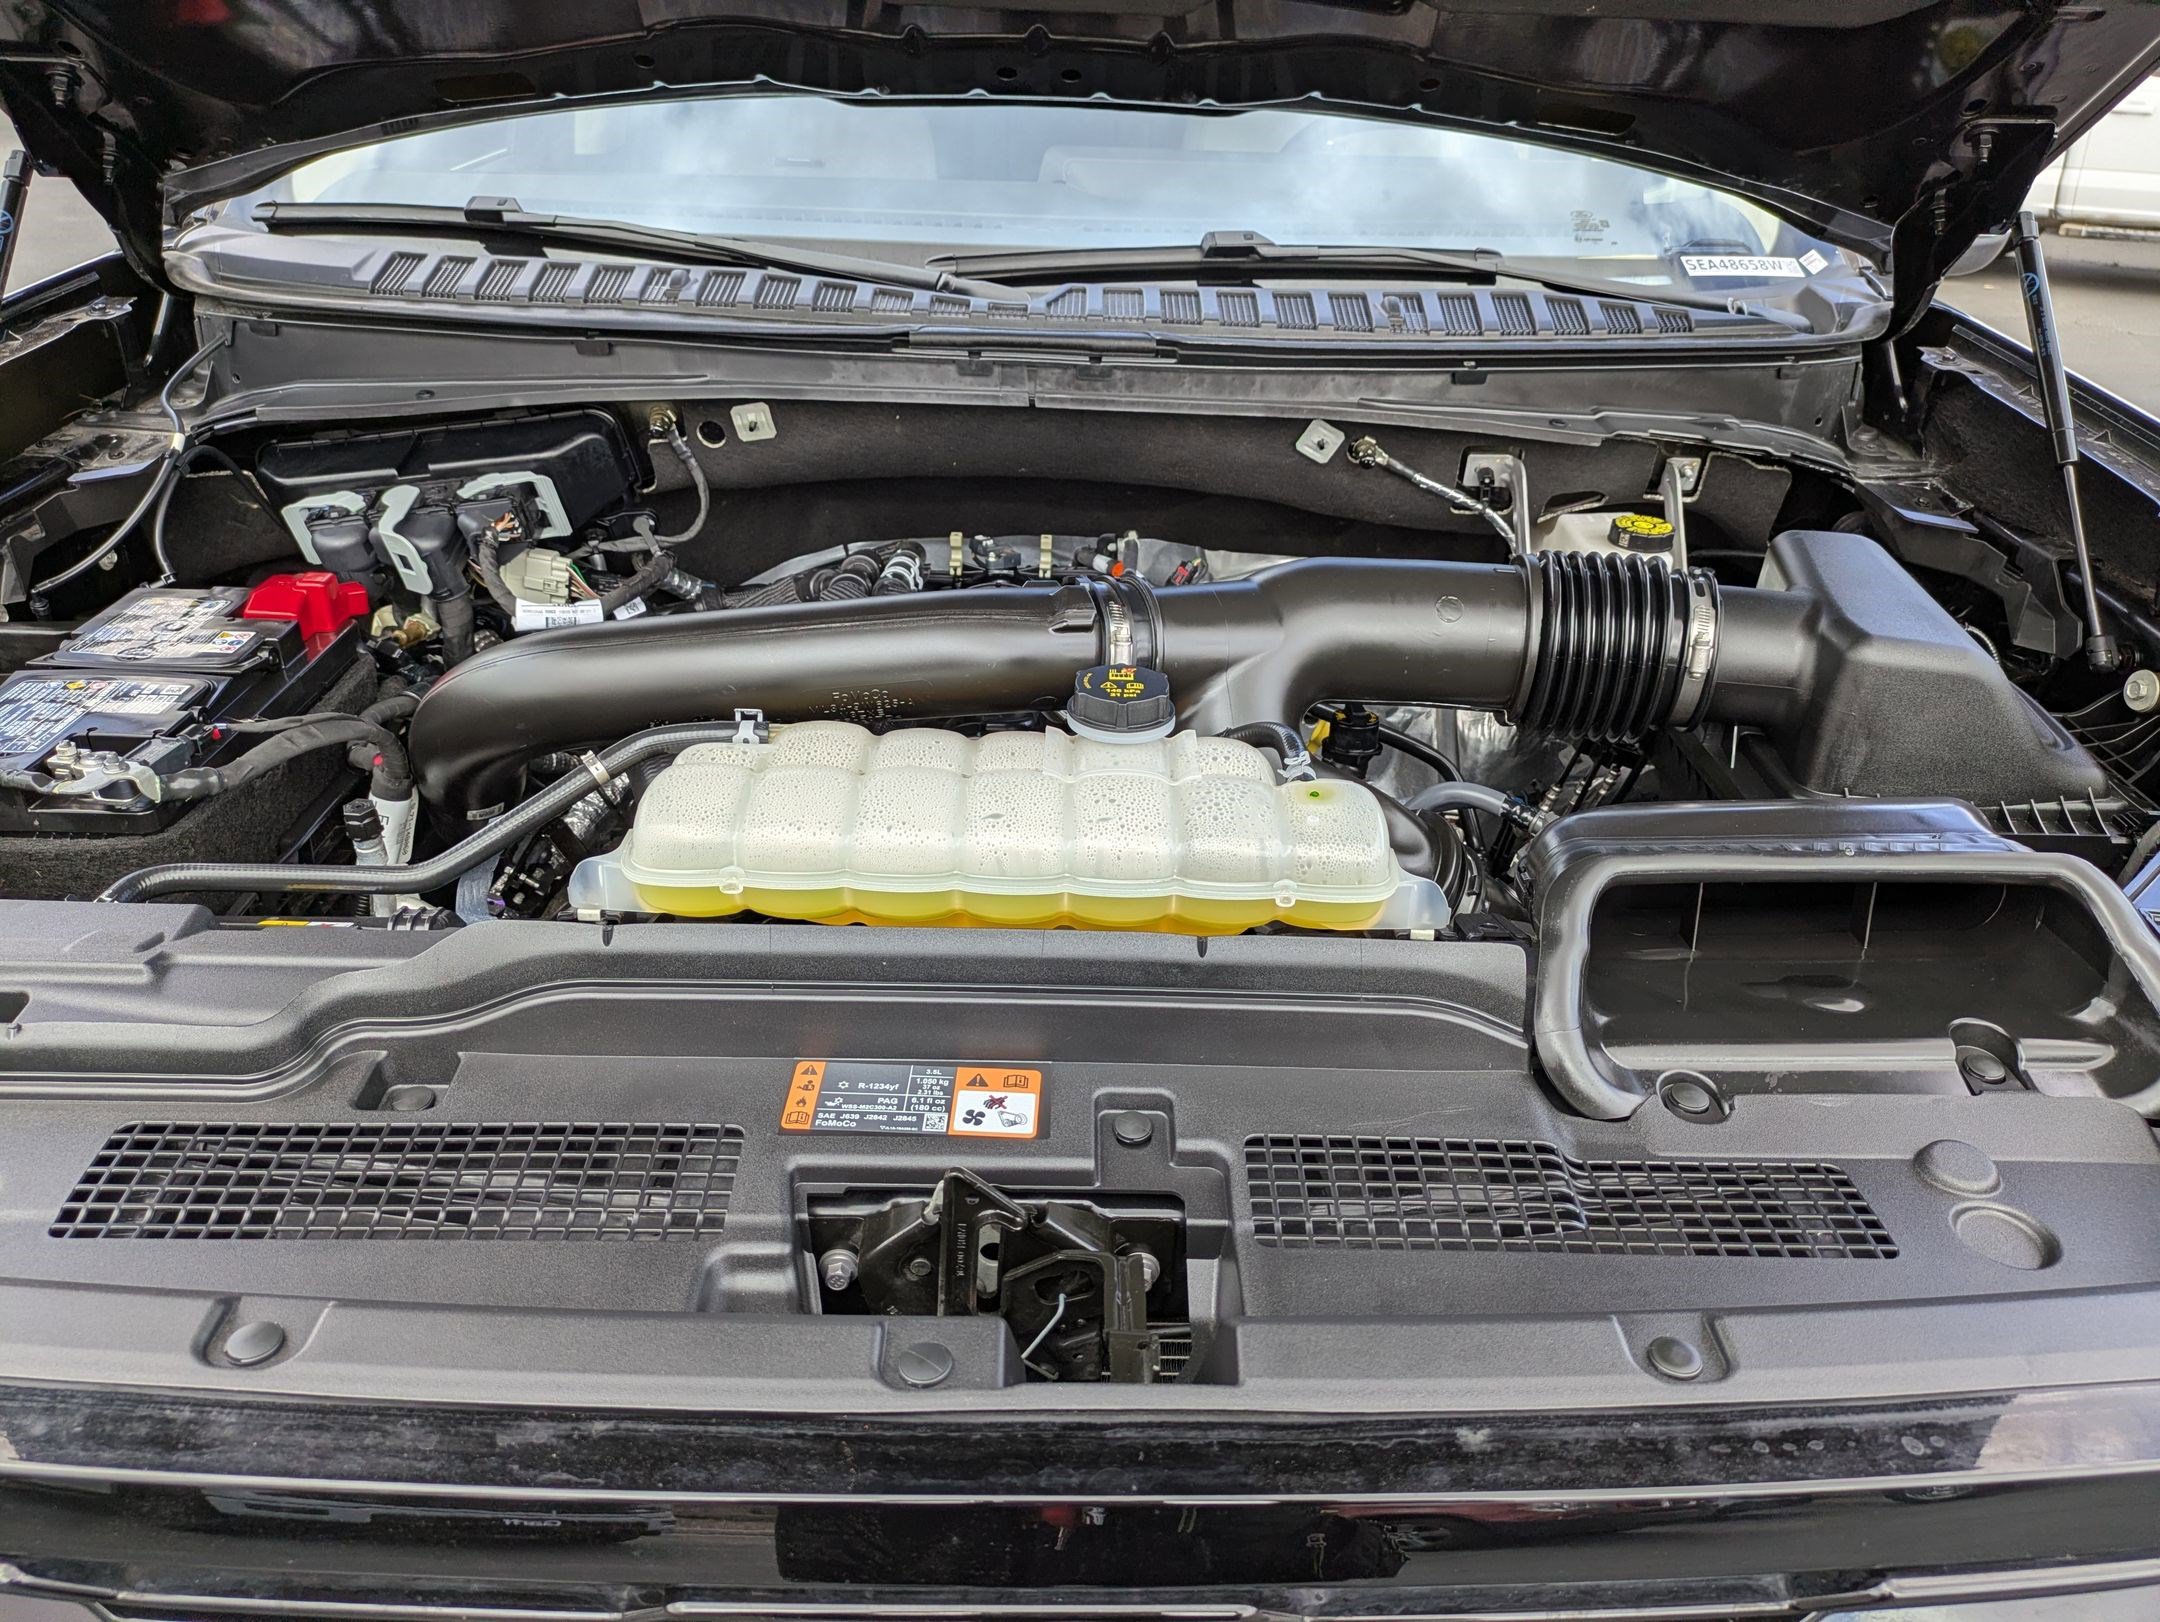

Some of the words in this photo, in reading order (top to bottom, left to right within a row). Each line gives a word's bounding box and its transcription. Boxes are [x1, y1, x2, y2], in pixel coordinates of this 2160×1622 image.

[1685, 259, 1783, 271] SEA48658W
[916, 1077, 938, 1085] 1.050
[938, 1078, 949, 1087] kg
[857, 1082, 900, 1092] R-1234yf
[877, 1097, 899, 1105] PAG
[911, 1096, 925, 1104] 6.1
[910, 1104, 930, 1112] (180
[815, 1119, 857, 1127] FoMoCo
